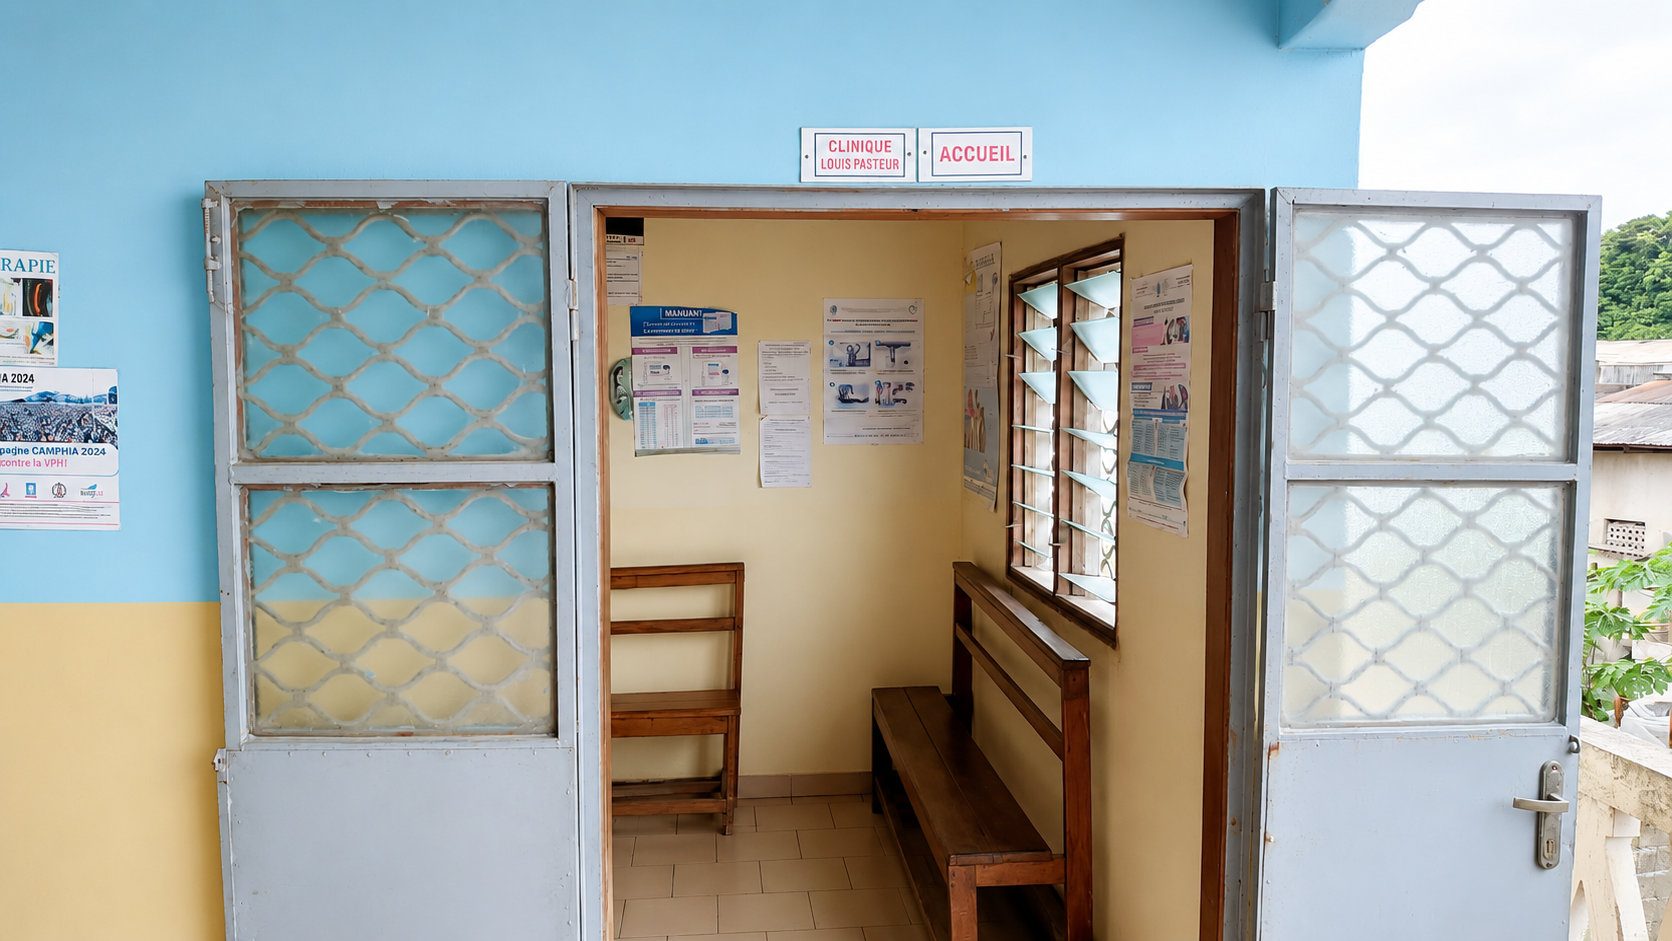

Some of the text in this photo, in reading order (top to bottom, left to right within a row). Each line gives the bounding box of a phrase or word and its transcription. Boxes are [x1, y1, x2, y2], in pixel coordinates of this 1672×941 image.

[828, 139, 892, 154] CLINIQUE
[939, 145, 1015, 162] ACCUEIL
[821, 157, 899, 170] LOUIS PASTEUR
[0, 257, 56, 274] RAPIE
[10, 373, 35, 384] 2024
[31, 446, 79, 456] CAMPHIA
[81, 447, 106, 456] 2024
[33, 457, 42, 467] la
